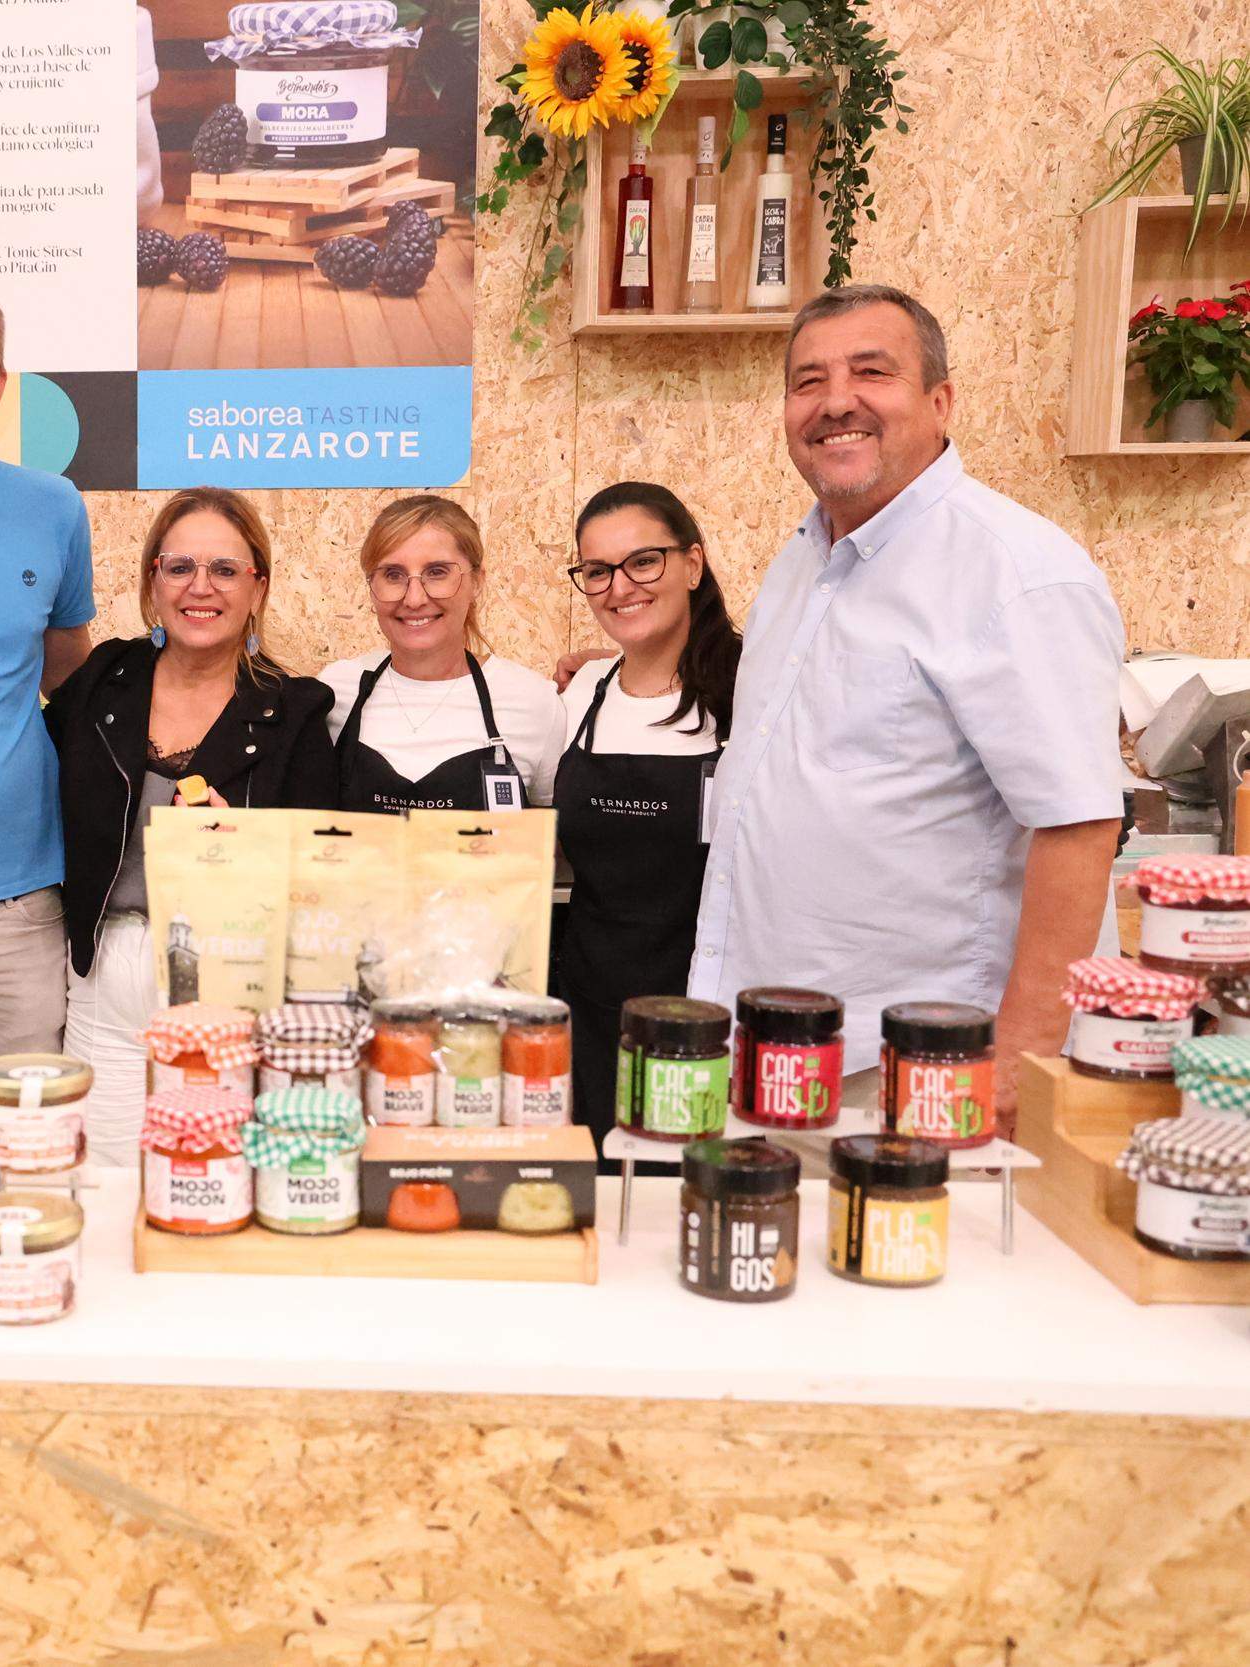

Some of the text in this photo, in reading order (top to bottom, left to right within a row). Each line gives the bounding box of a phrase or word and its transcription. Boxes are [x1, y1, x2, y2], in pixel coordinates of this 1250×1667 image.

[2, 46, 16, 58] de
[21, 45, 44, 58] Los
[47, 44, 84, 57] Valles
[87, 45, 111, 57] con
[32, 64, 40, 73] a
[43, 60, 72, 72] base
[75, 59, 92, 72] de
[8, 77, 66, 90] crujiente
[281, 106, 330, 119] MORA
[22, 122, 38, 135] de
[41, 121, 100, 135] confitura
[18, 184, 34, 197] de
[37, 184, 65, 199] pata
[67, 183, 104, 196] asada
[6, 246, 40, 258] Tonic
[10, 260, 57, 274] PitaGin
[187, 431, 420, 459] LANZAROTE
[374, 794, 454, 808] BERNARDOS
[590, 797, 668, 811] BERNARDOS
[761, 1052, 802, 1084] CAC
[651, 1063, 693, 1095] CAC
[910, 1067, 954, 1098] CAC
[385, 1090, 423, 1100] MOJO
[454, 1092, 492, 1102] MOJO
[523, 1091, 562, 1101] MOJO
[761, 1082, 802, 1115] TUS
[454, 1103, 492, 1114] VERDE
[651, 1095, 691, 1126] TUS
[911, 1097, 953, 1131] TUS
[170, 1180, 222, 1191] MOJO
[288, 1178, 340, 1190] MOJO
[287, 1192, 341, 1204] VERDE
[731, 1221, 755, 1256] HI
[730, 1257, 776, 1292] GOS
